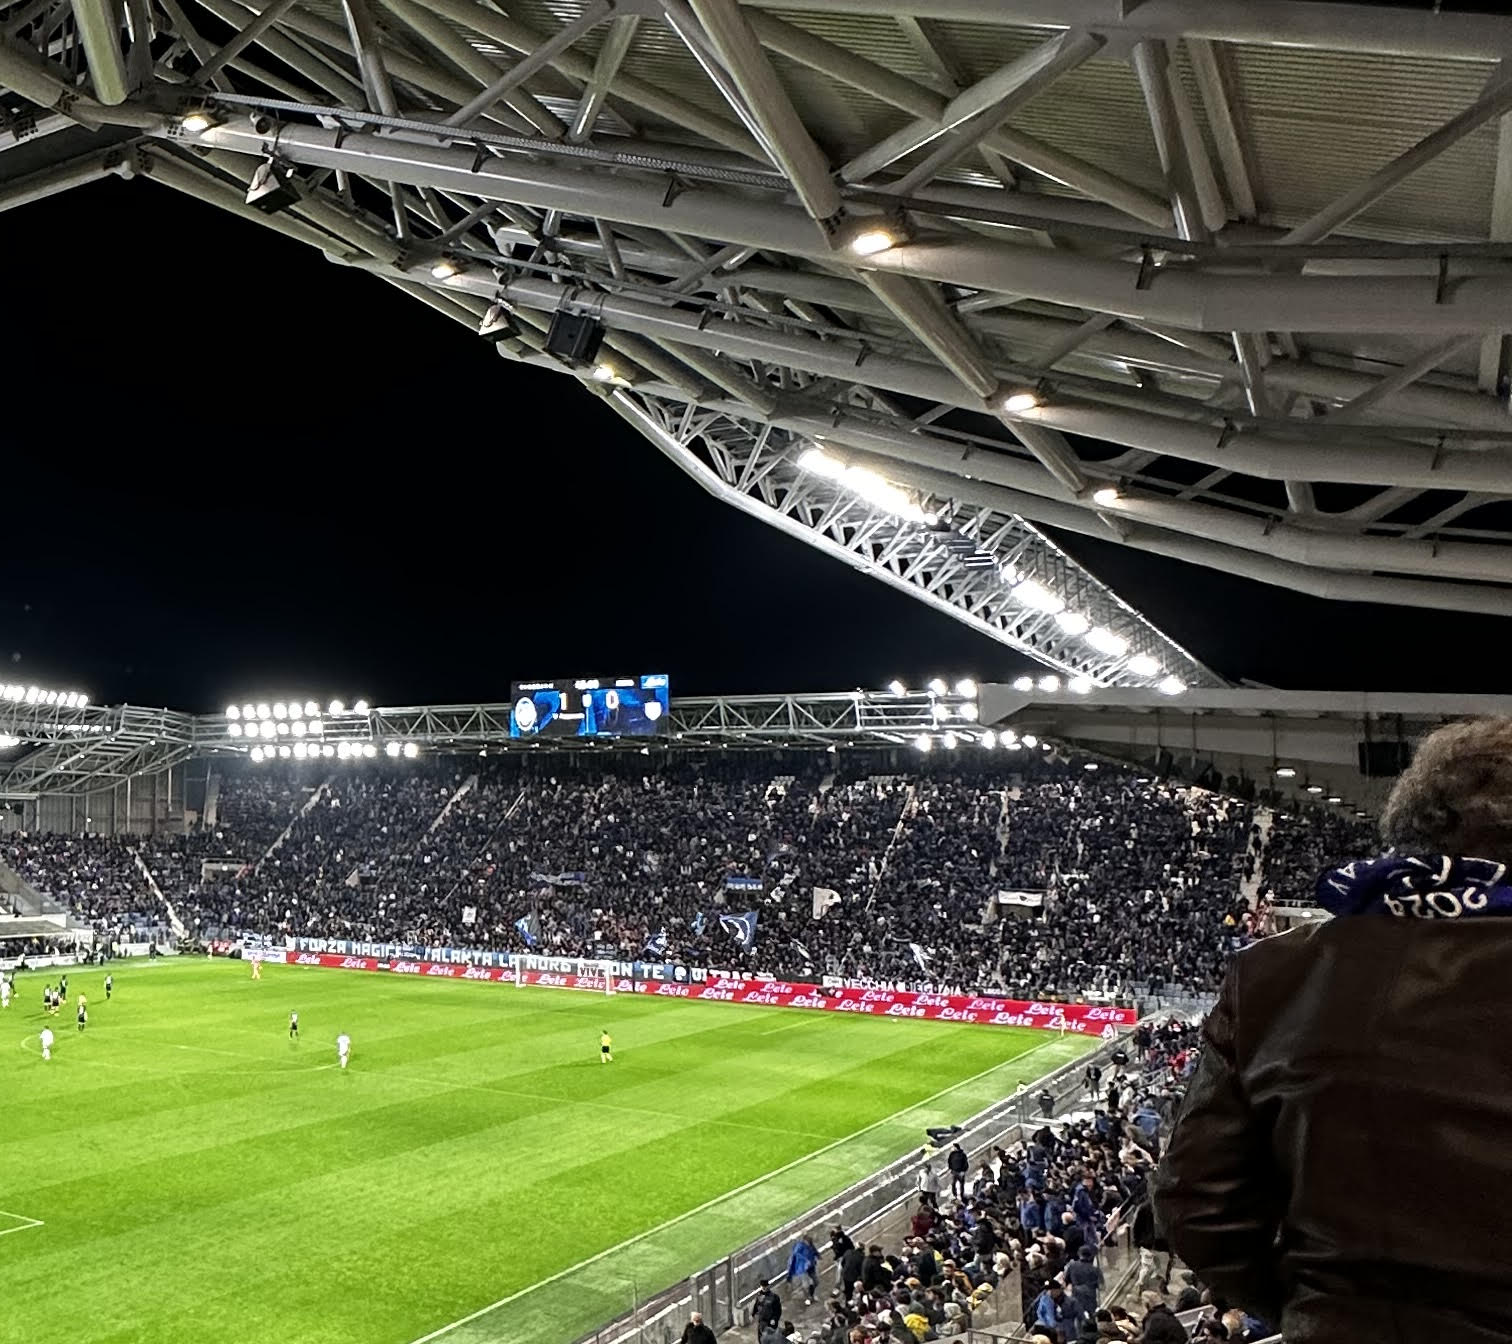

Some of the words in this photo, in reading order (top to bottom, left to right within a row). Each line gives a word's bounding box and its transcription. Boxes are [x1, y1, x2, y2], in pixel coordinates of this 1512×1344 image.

[559, 693, 567, 710] 1
[300, 937, 346, 953] FORZA
[641, 964, 665, 980] TE
[844, 977, 895, 992] VECCHIA
